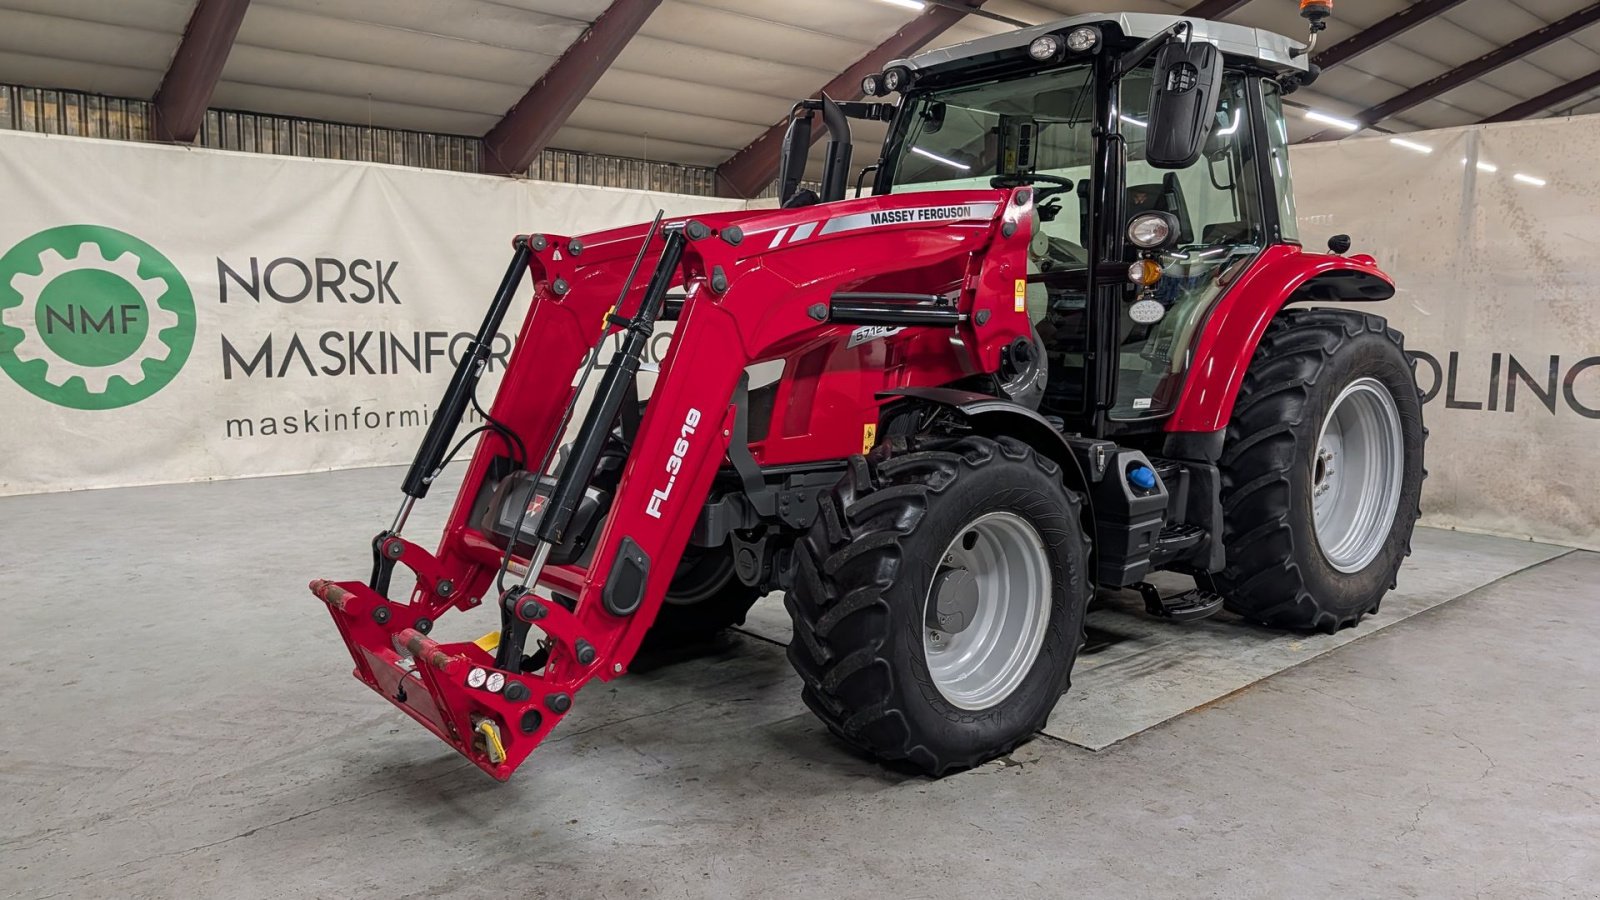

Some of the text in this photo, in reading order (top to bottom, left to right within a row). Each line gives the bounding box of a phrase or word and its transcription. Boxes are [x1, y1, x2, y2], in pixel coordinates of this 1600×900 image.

[870, 206, 971, 225] MASSEY FERGUSON
[216, 256, 402, 304] NORSK
[46, 304, 140, 335] NMF
[856, 325, 883, 341] 5712
[645, 407, 702, 519] FL.3619
